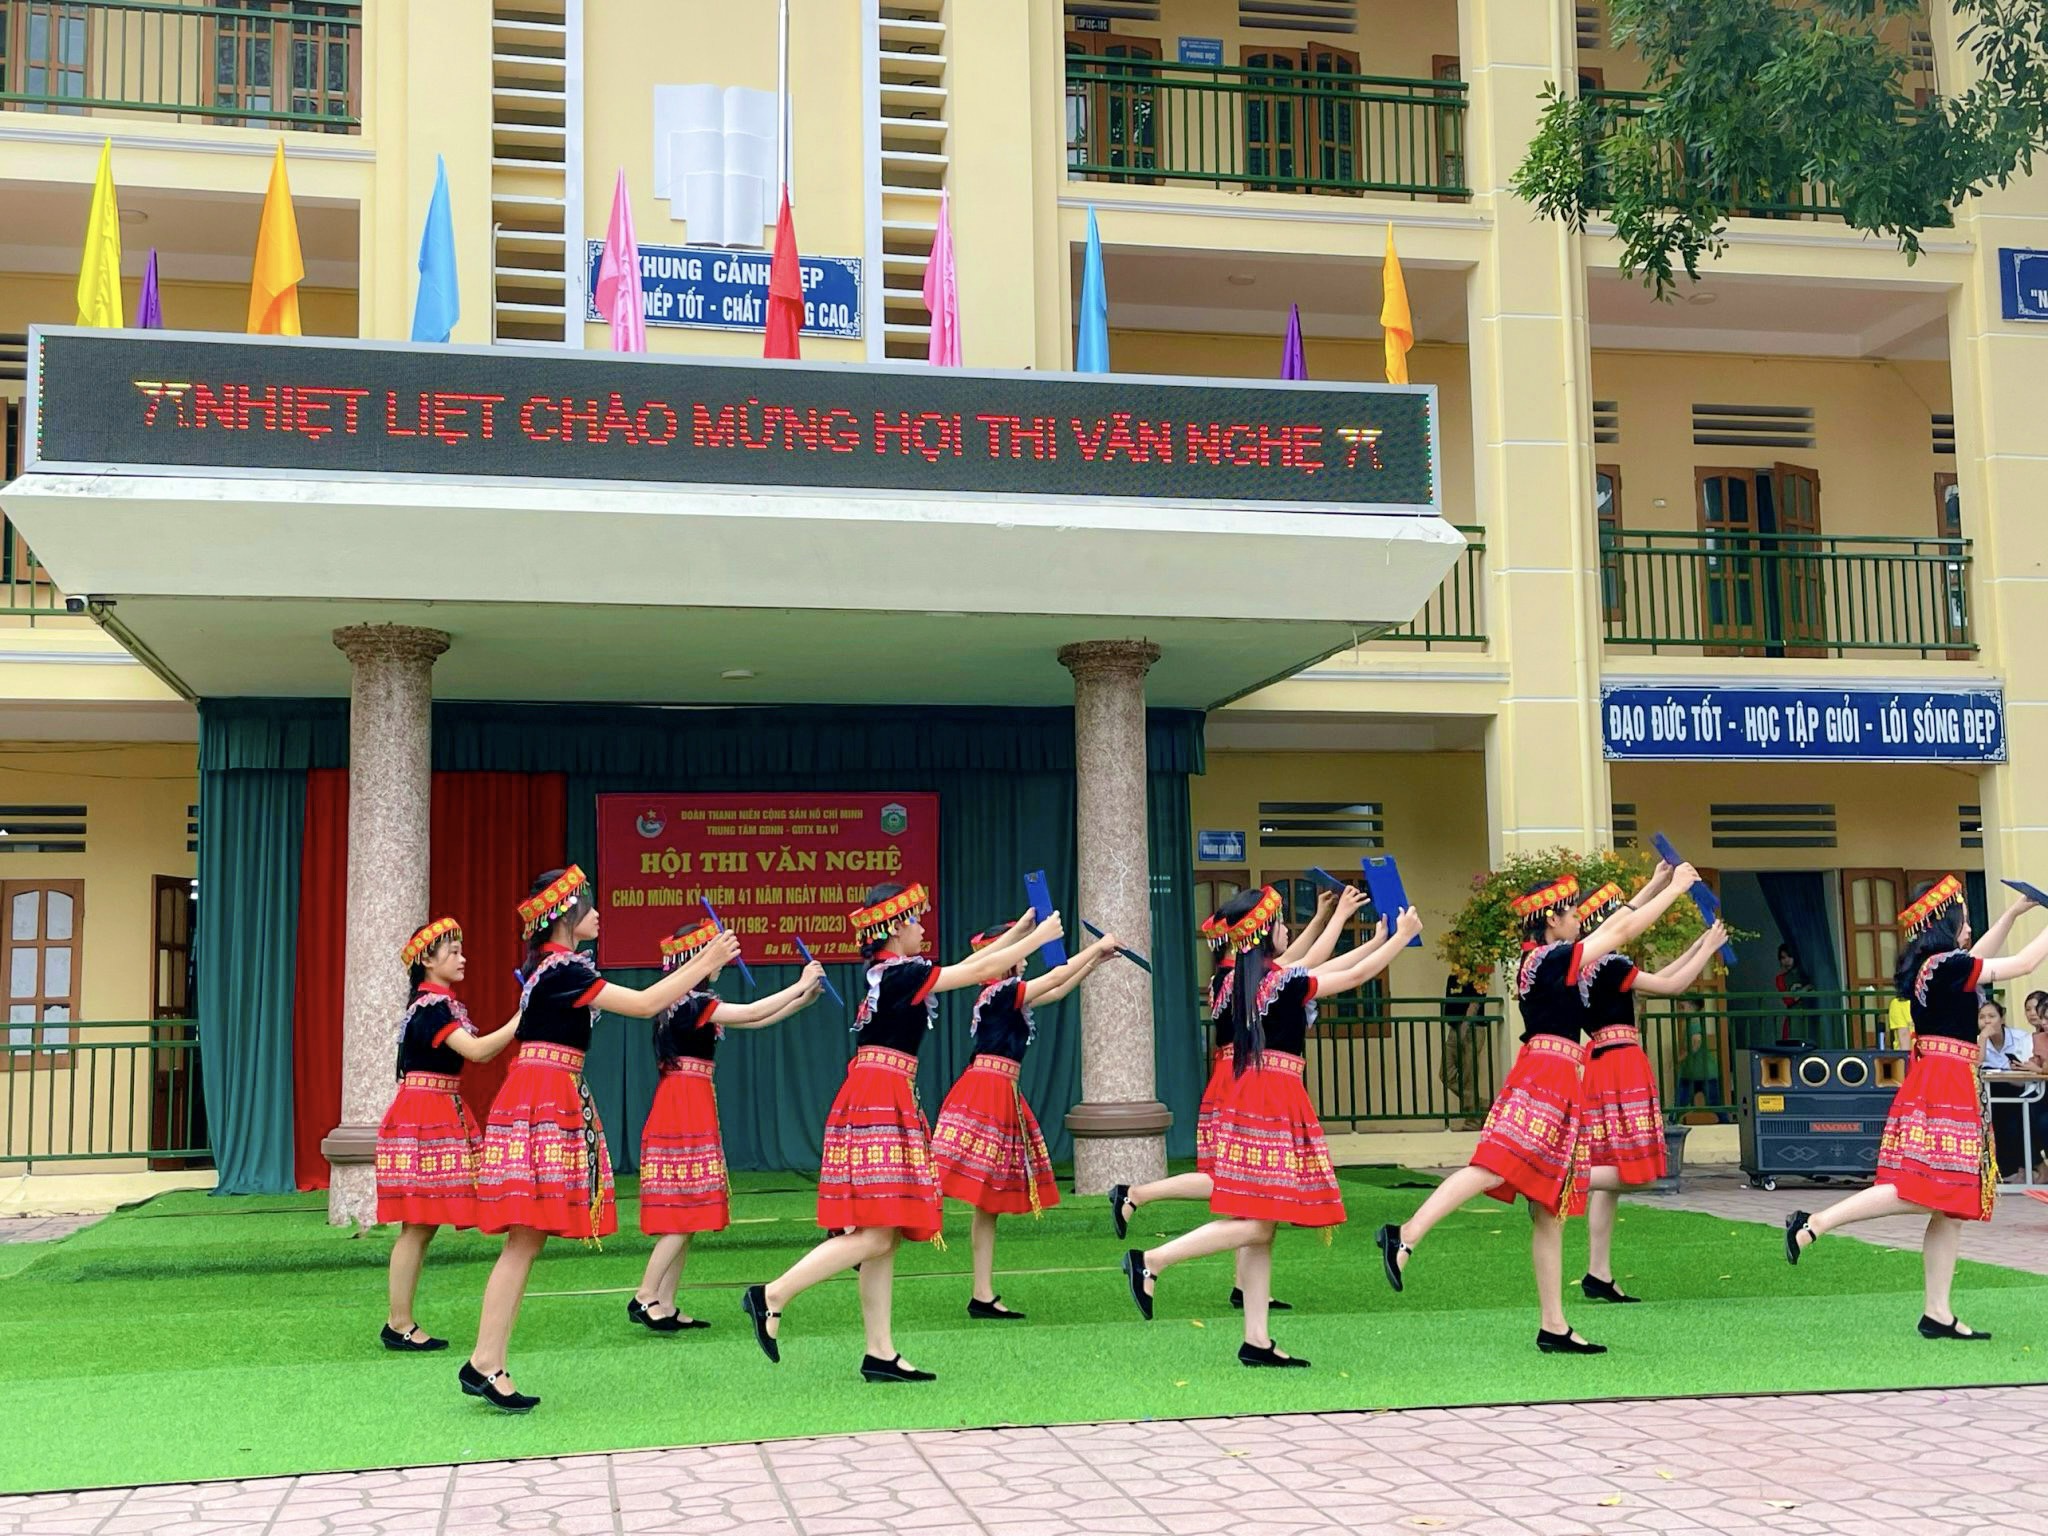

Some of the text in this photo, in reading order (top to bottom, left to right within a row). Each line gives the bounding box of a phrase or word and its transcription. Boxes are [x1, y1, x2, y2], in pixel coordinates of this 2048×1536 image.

[640, 255, 703, 281] HUNG
[677, 286, 704, 319] TỐT
[722, 289, 762, 323] CHẤT
[818, 301, 849, 329] CAO
[976, 413, 1057, 460] THI
[1609, 705, 1645, 747] ĐẠO
[1651, 696, 1687, 741] ĐỨC
[1691, 694, 1722, 741] TỐT
[1745, 706, 1780, 748] HỌC
[1785, 700, 1819, 748] TẬP
[1825, 694, 1860, 743] GIỎI
[1880, 696, 1908, 743] LỐI
[1913, 697, 1960, 743] SỐNG
[1963, 708, 1996, 750] ĐẸP
[708, 810, 737, 820] THANH
[762, 808, 786, 821] CỘNG
[840, 809, 863, 819] MINH
[706, 825, 736, 836] TRUNG
[738, 824, 757, 836] TÂM
[816, 825, 828, 835] BA
[640, 845, 902, 879] HỘI THI VĂN NGHỆ
[612, 886, 644, 907] CHÀO
[647, 885, 683, 907] MỪNG
[738, 888, 751, 905] 41
[755, 885, 783, 905] NĂM
[786, 884, 817, 904] NGÀY
[820, 884, 843, 903] NHÀ
[779, 915, 846, 934] 20/11/2023)
[824, 942, 836, 954] 12
